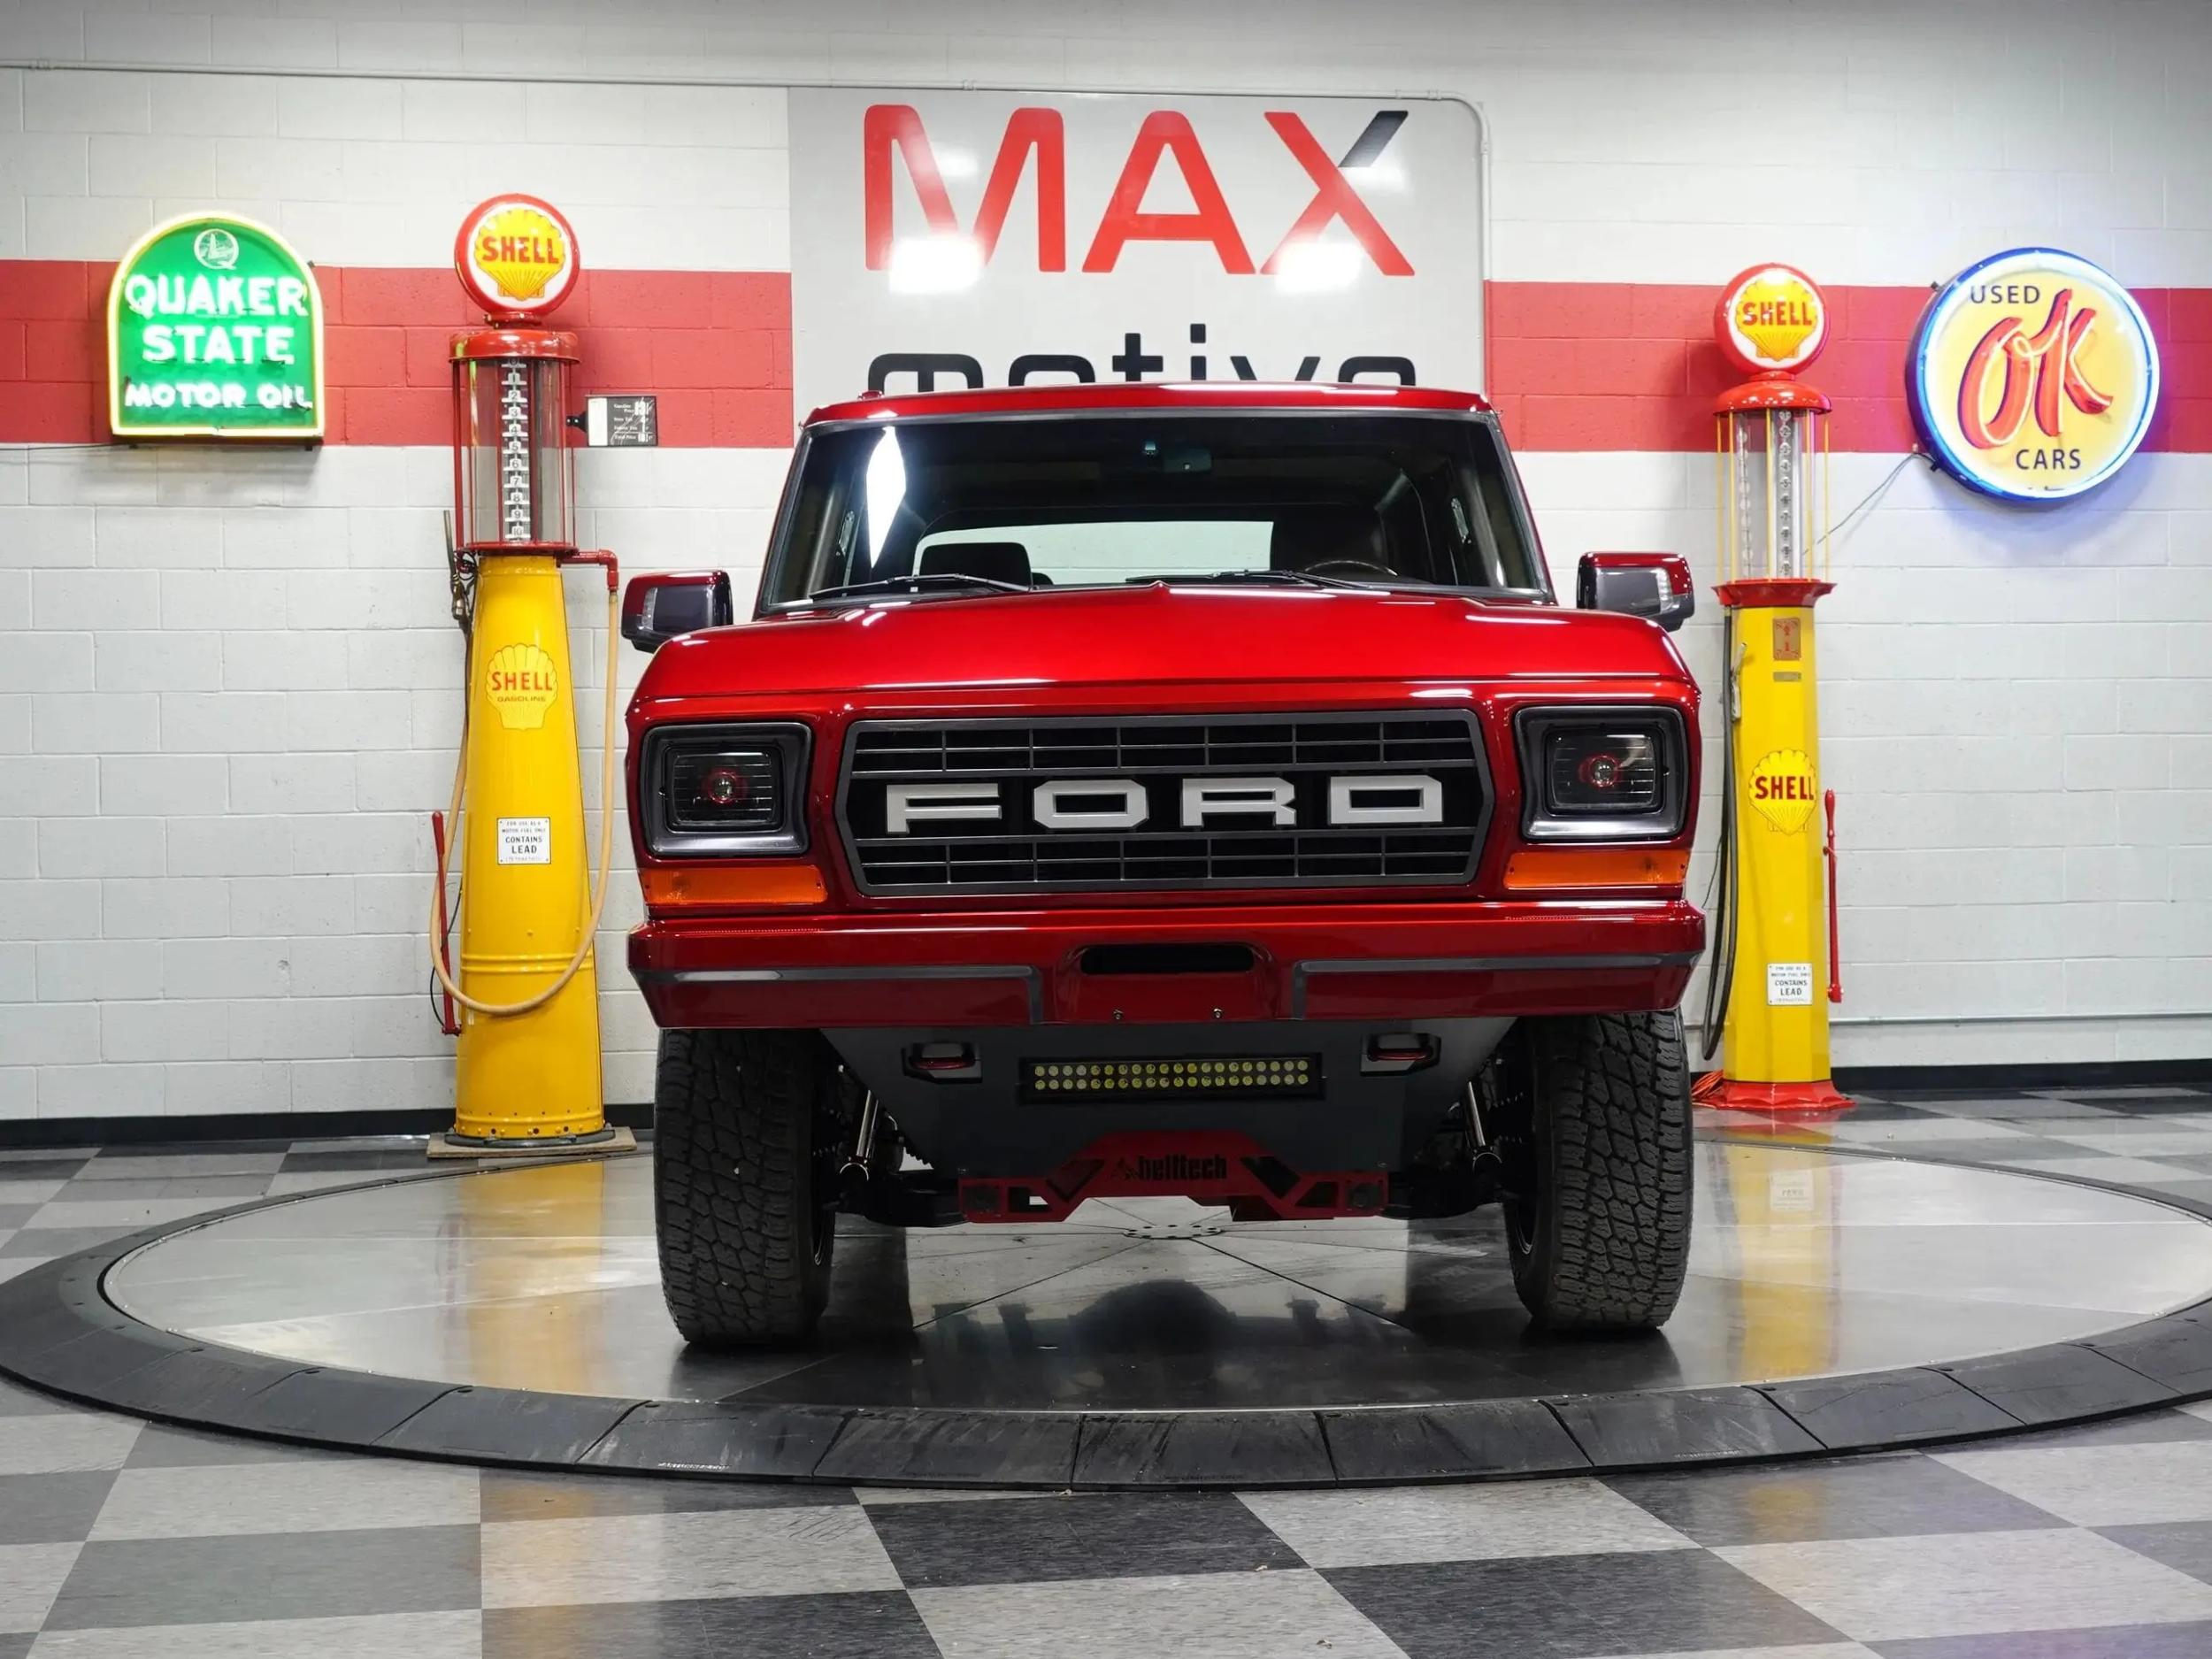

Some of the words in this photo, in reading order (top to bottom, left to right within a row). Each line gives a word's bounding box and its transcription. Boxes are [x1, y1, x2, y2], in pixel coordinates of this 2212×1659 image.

[864, 104, 1416, 277] MAX
[481, 235, 559, 265] SHELL
[125, 273, 309, 320] QUAKER
[1970, 284, 2040, 304] USED
[1741, 301, 1813, 326] SHELL
[142, 325, 296, 365] STATE
[1957, 288, 2114, 449] OK
[125, 382, 247, 409] MOTOR
[257, 382, 313, 410] OIL
[2015, 449, 2082, 471] CARS
[491, 671, 553, 692] SHELL
[1754, 775, 1815, 801] SHELL
[887, 774, 1444, 835] FORD
[511, 845, 537, 854] LEAD
[1780, 987, 1802, 996] LEAD
